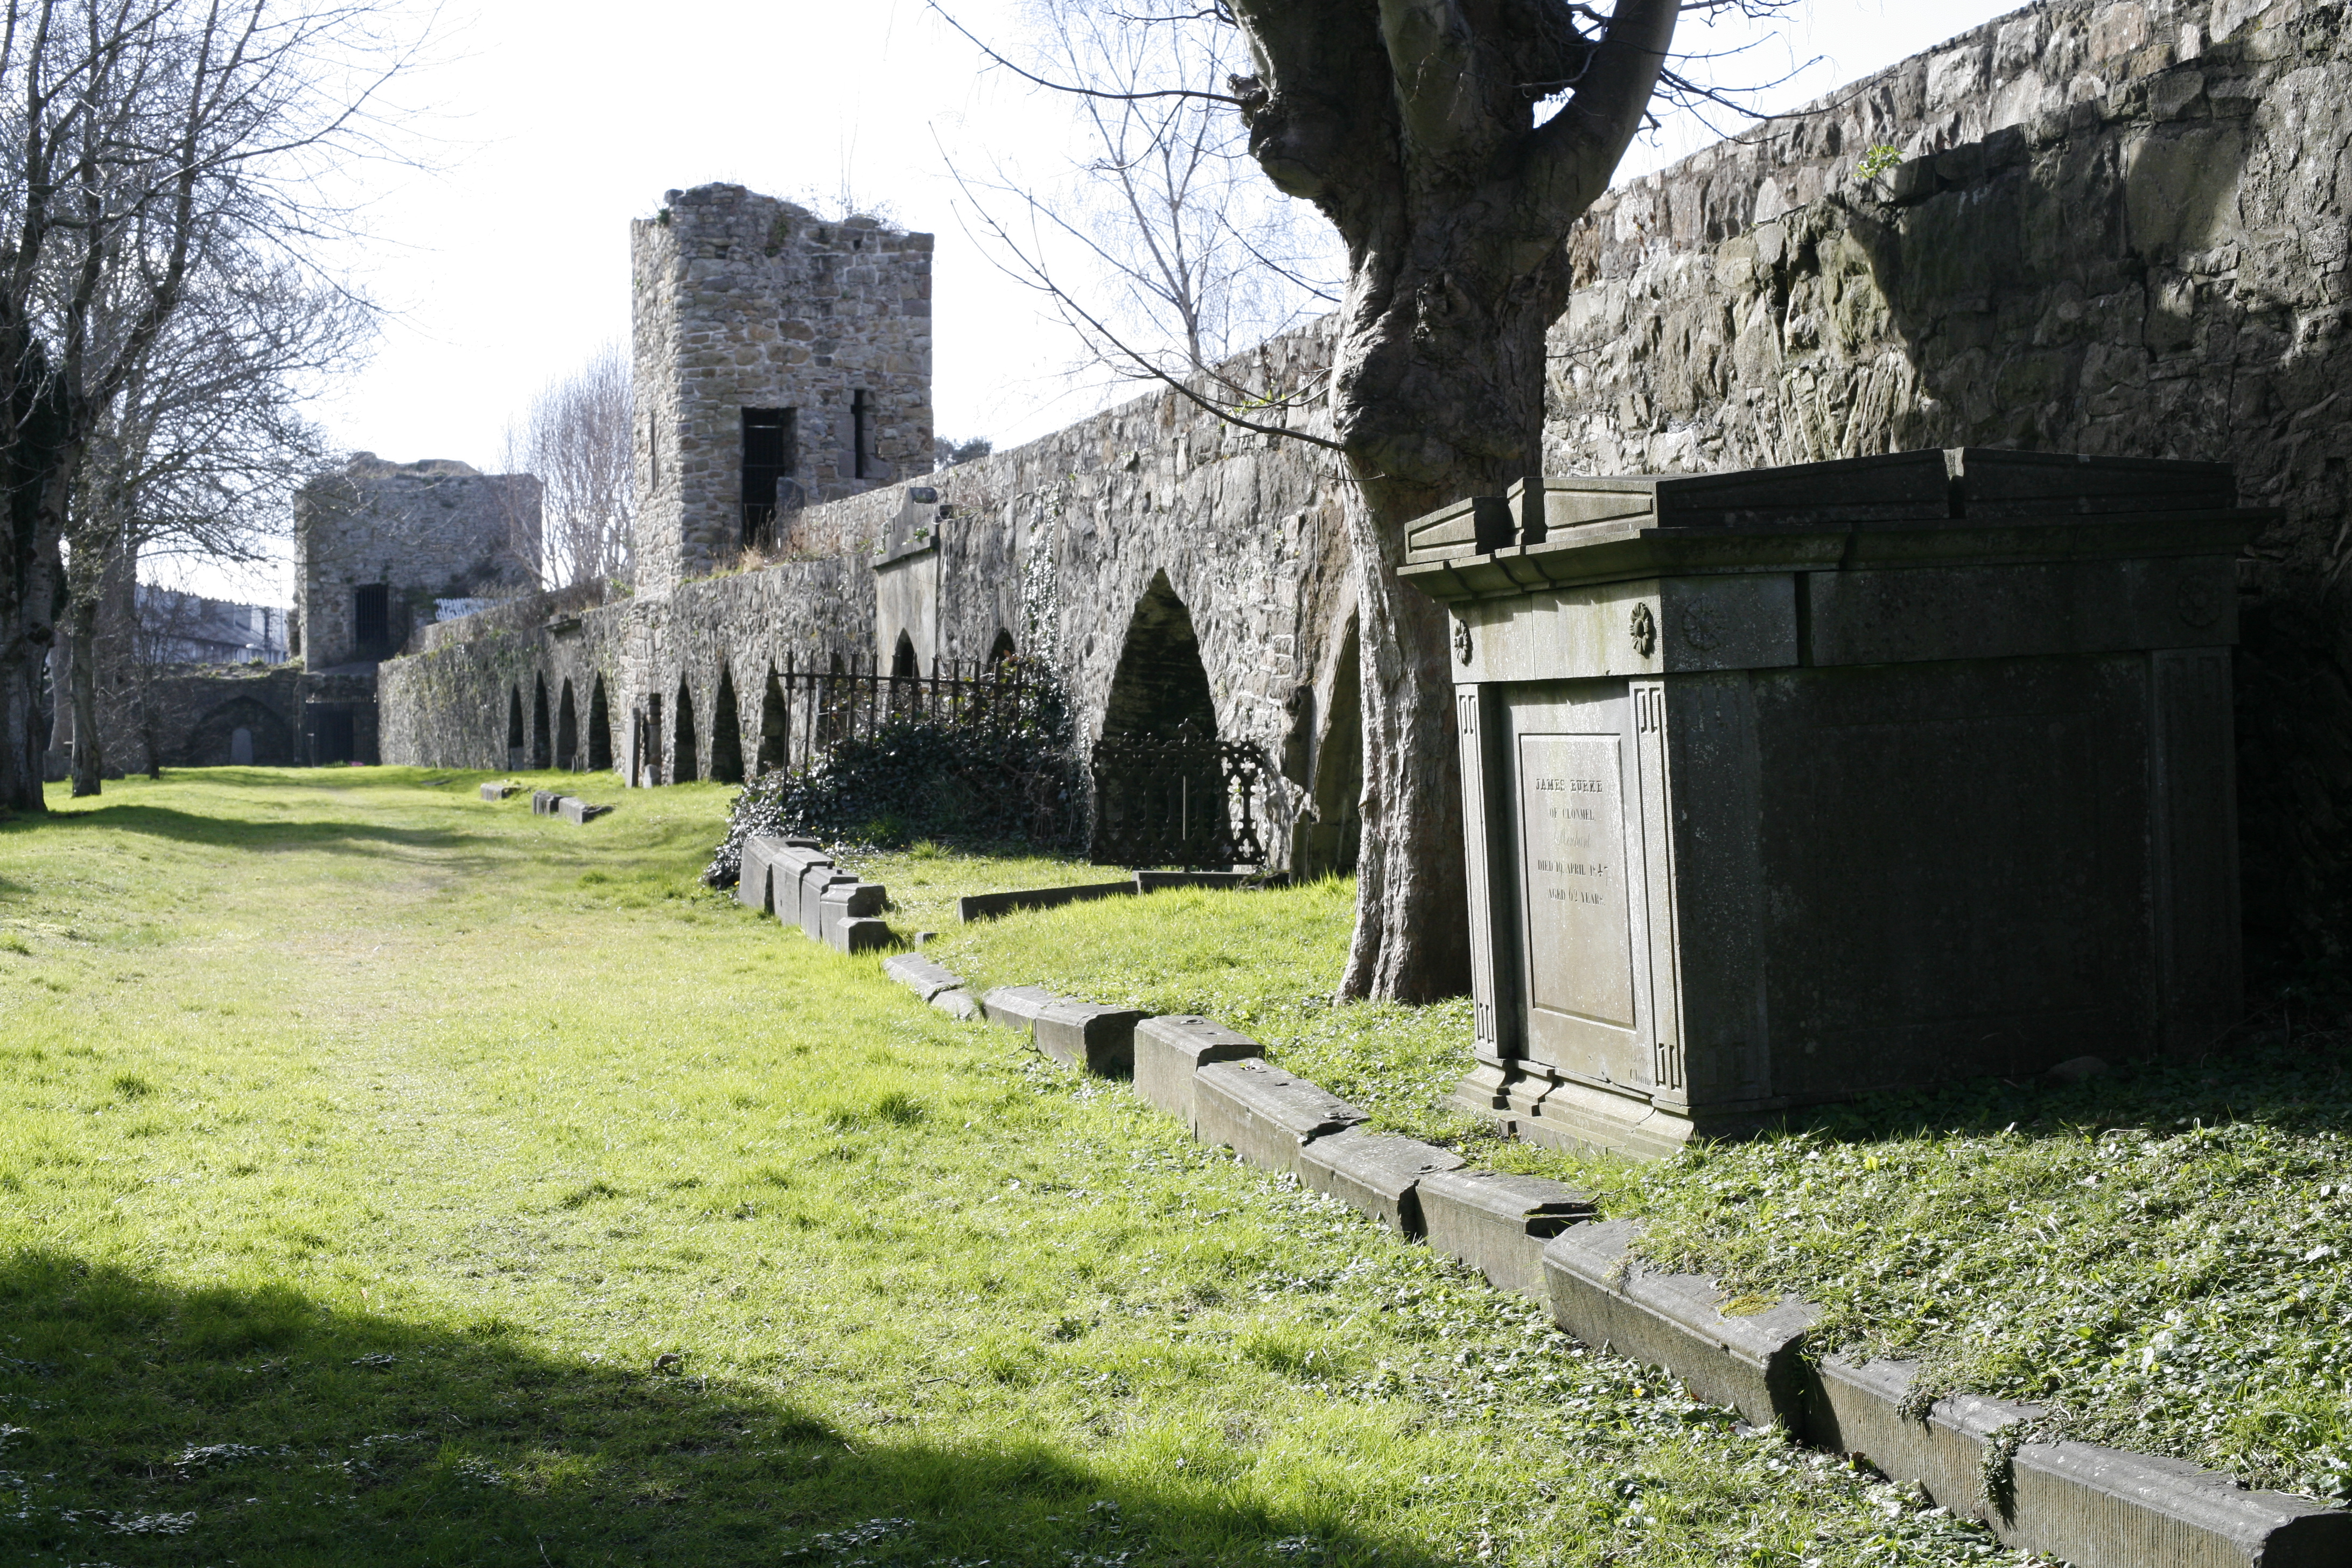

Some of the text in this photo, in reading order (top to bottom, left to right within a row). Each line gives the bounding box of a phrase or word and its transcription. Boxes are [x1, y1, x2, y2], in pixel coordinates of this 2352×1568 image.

[1536, 778, 1603, 793] JAMES BURKE
[1549, 807, 1558, 818] OF
[1537, 859, 1553, 871] DIED
[1566, 862, 1586, 876] APRIL
[1548, 886, 1566, 900] AGED
